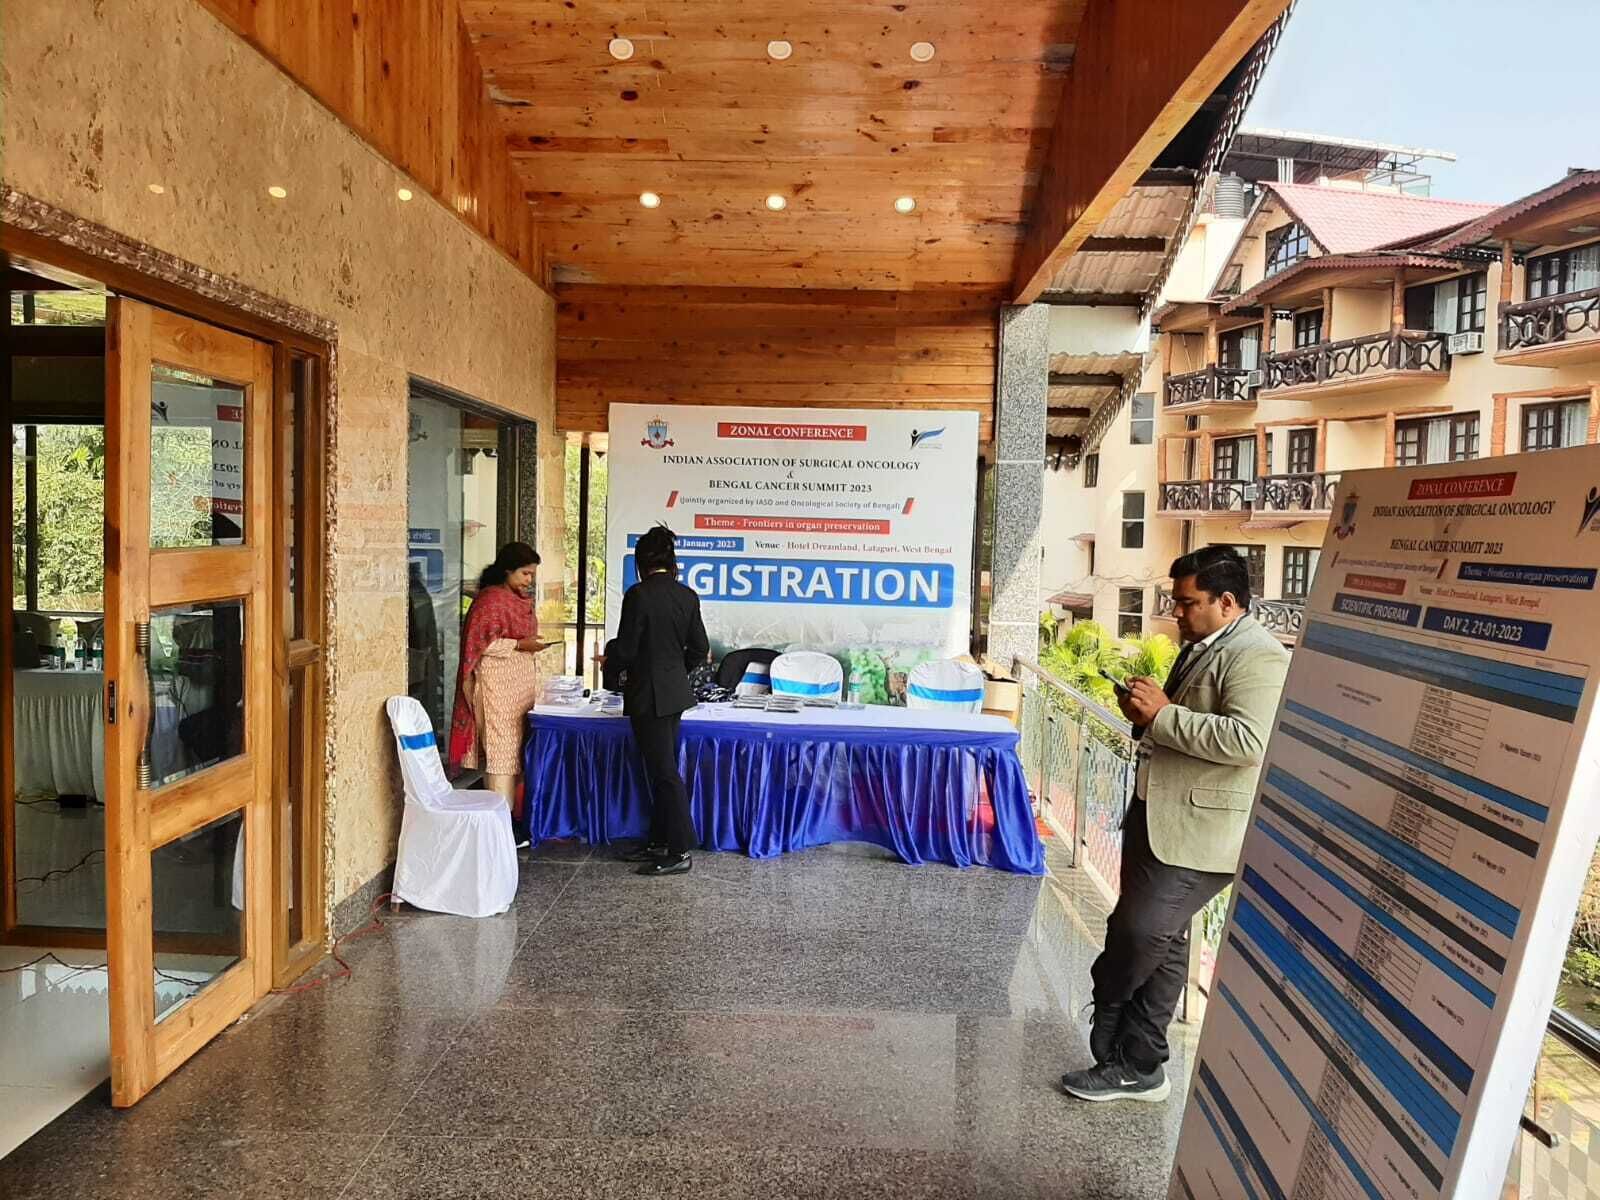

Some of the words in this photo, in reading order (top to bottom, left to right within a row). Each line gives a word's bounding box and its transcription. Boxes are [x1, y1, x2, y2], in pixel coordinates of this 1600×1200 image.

[730, 425, 771, 436] ZONAL
[773, 426, 854, 438] CONFERENCE
[663, 455, 703, 465] INDIAN
[705, 455, 779, 466] ASSOCIATION
[782, 457, 796, 467] OF
[799, 458, 852, 469] SURGICAL
[856, 460, 920, 471] ONCOLOGY
[708, 480, 752, 490] BENGAL
[754, 480, 800, 491] CANCER
[802, 482, 847, 493] SUMMIT
[849, 484, 872, 493] 2023
[1415, 482, 1442, 496] ZONAL
[1443, 479, 1505, 495] CONFERENCE
[709, 497, 744, 506] organized
[745, 498, 755, 507] by
[756, 498, 773, 506] IASO
[790, 499, 835, 509] Oncological
[835, 501, 861, 510] Society
[863, 501, 871, 509] of
[1456, 503, 1498, 517] SURGICAL
[1498, 500, 1556, 515] ONCOLOGY
[704, 516, 735, 528] Theme
[742, 518, 782, 529] Frontiers
[785, 519, 794, 529] in
[796, 521, 822, 532] organ
[823, 522, 880, 532] preservation
[683, 539, 715, 550] January
[716, 540, 736, 549] 2023
[755, 539, 780, 550] Venue
[787, 540, 810, 550] Hotel
[902, 544, 922, 553] West
[924, 545, 952, 555] Bengal
[1390, 539, 1417, 551] BENGAL
[1418, 540, 1449, 553] CANCER
[1448, 541, 1484, 554] SUMMIT
[1483, 542, 1503, 554] 2023
[637, 561, 939, 602] GISTRATION
[1340, 598, 1374, 616] SCIENTIFIC
[1373, 604, 1410, 622] PROGRAM
[1442, 615, 1462, 632] DAY
[1470, 620, 1523, 642] 21-01-2023
